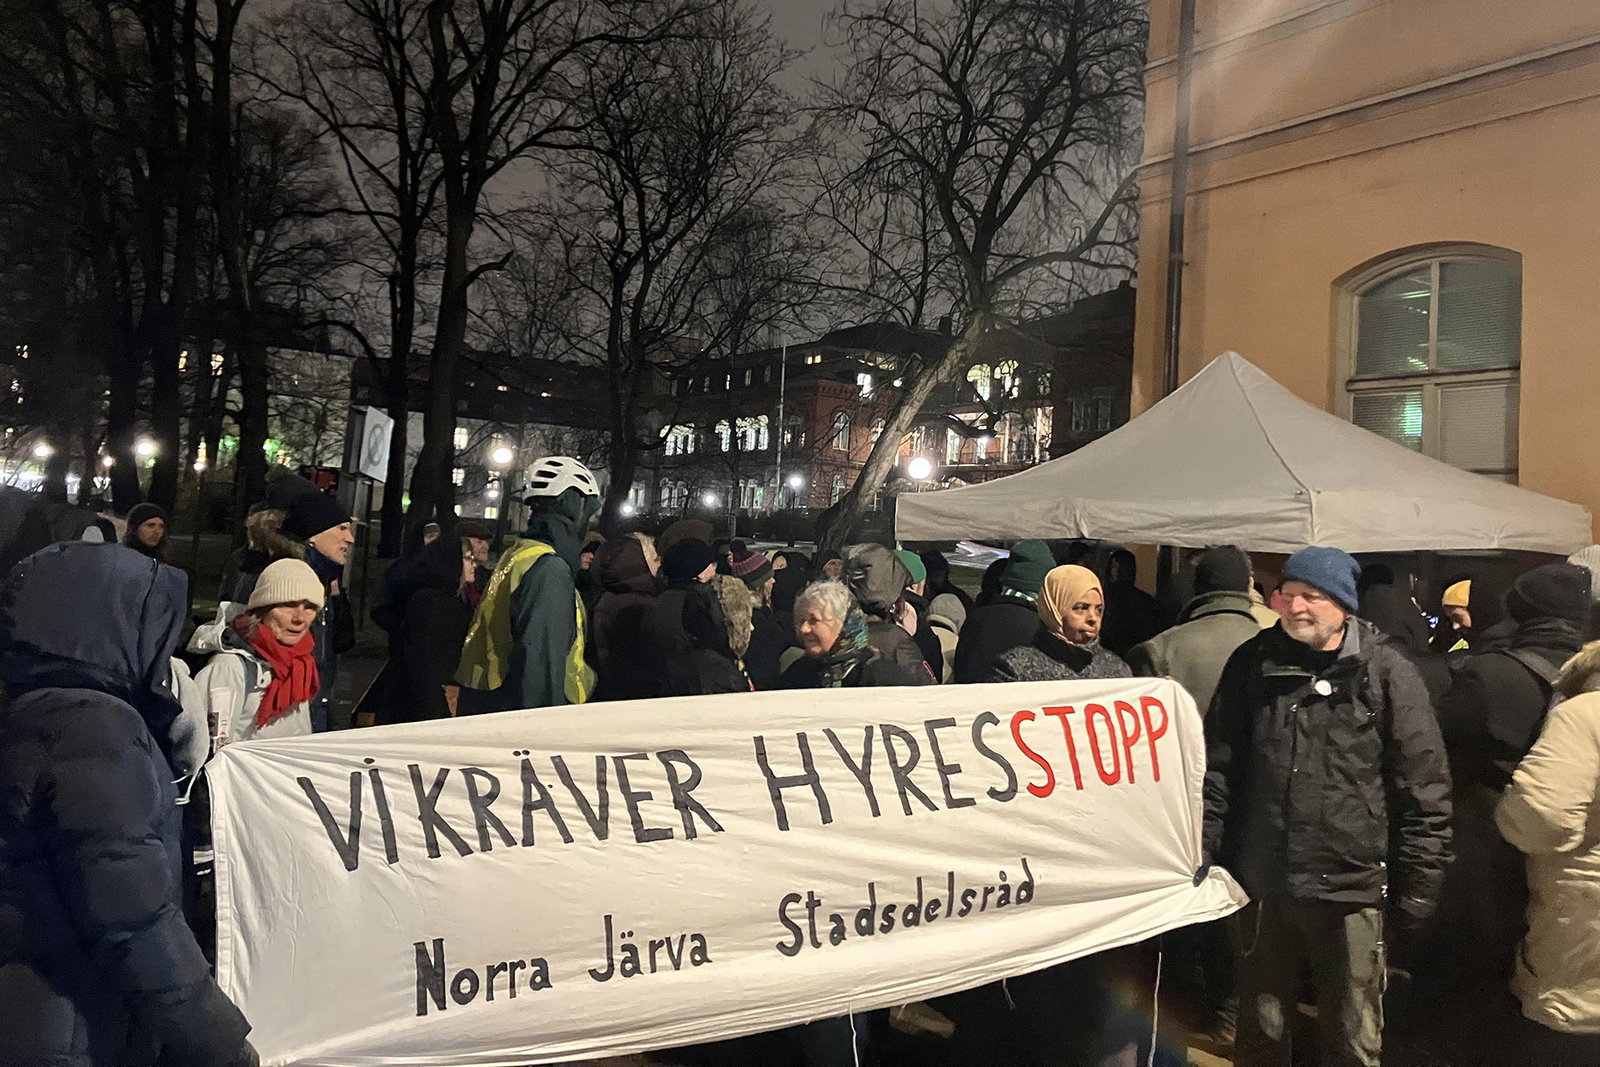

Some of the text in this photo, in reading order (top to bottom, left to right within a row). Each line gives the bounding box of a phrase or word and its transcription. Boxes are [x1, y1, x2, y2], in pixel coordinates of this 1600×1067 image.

[413, 857, 1035, 1016] Norra Järva Stadsdelsråd
